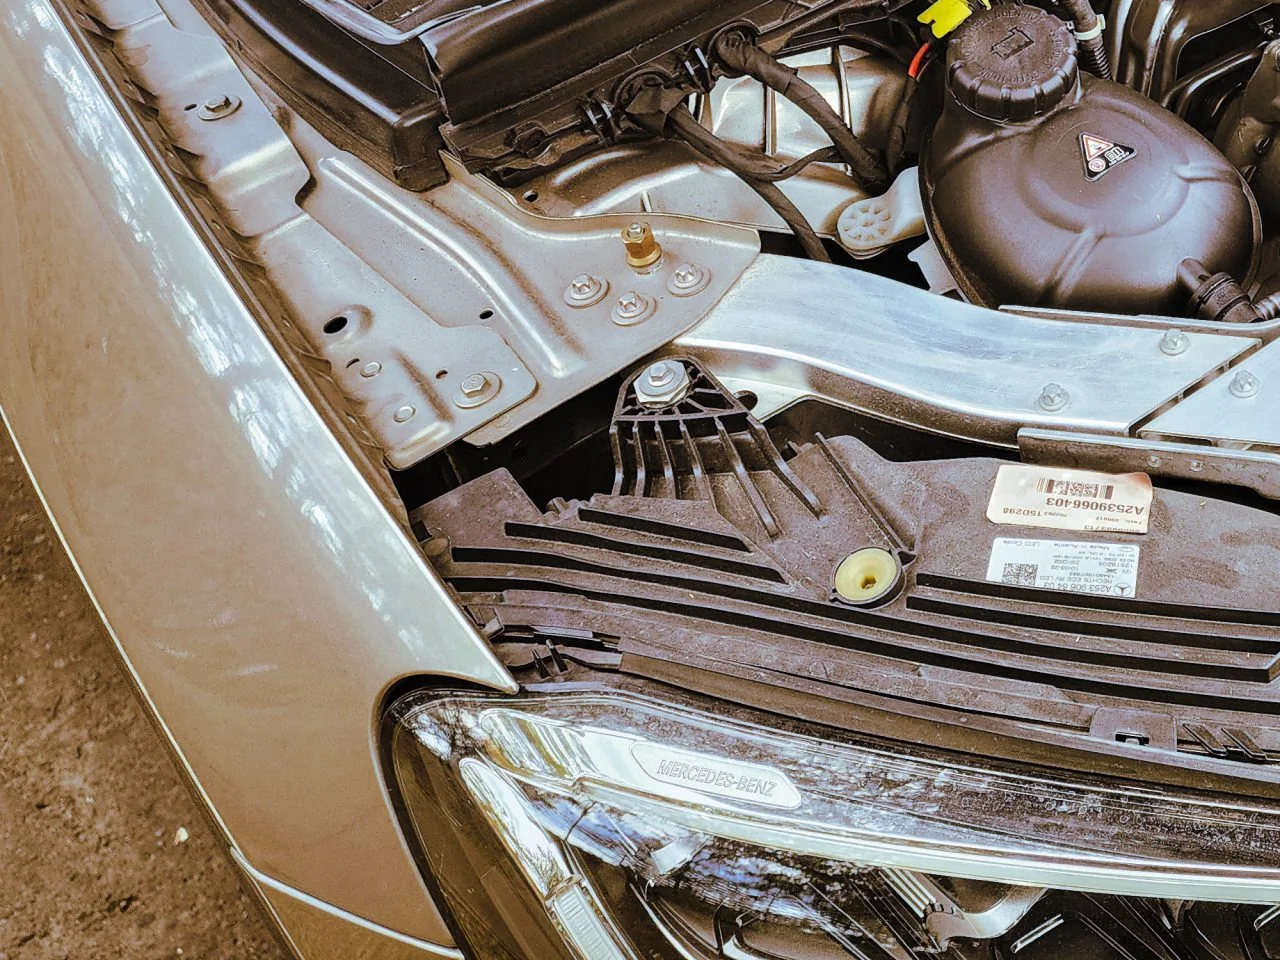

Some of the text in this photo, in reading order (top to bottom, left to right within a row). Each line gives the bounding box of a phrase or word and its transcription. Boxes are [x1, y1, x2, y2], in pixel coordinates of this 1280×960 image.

[1046, 497, 1145, 515] A2539066403
[1089, 584, 1112, 593] A253
[656, 759, 779, 797] MERCEDES-BENZ
